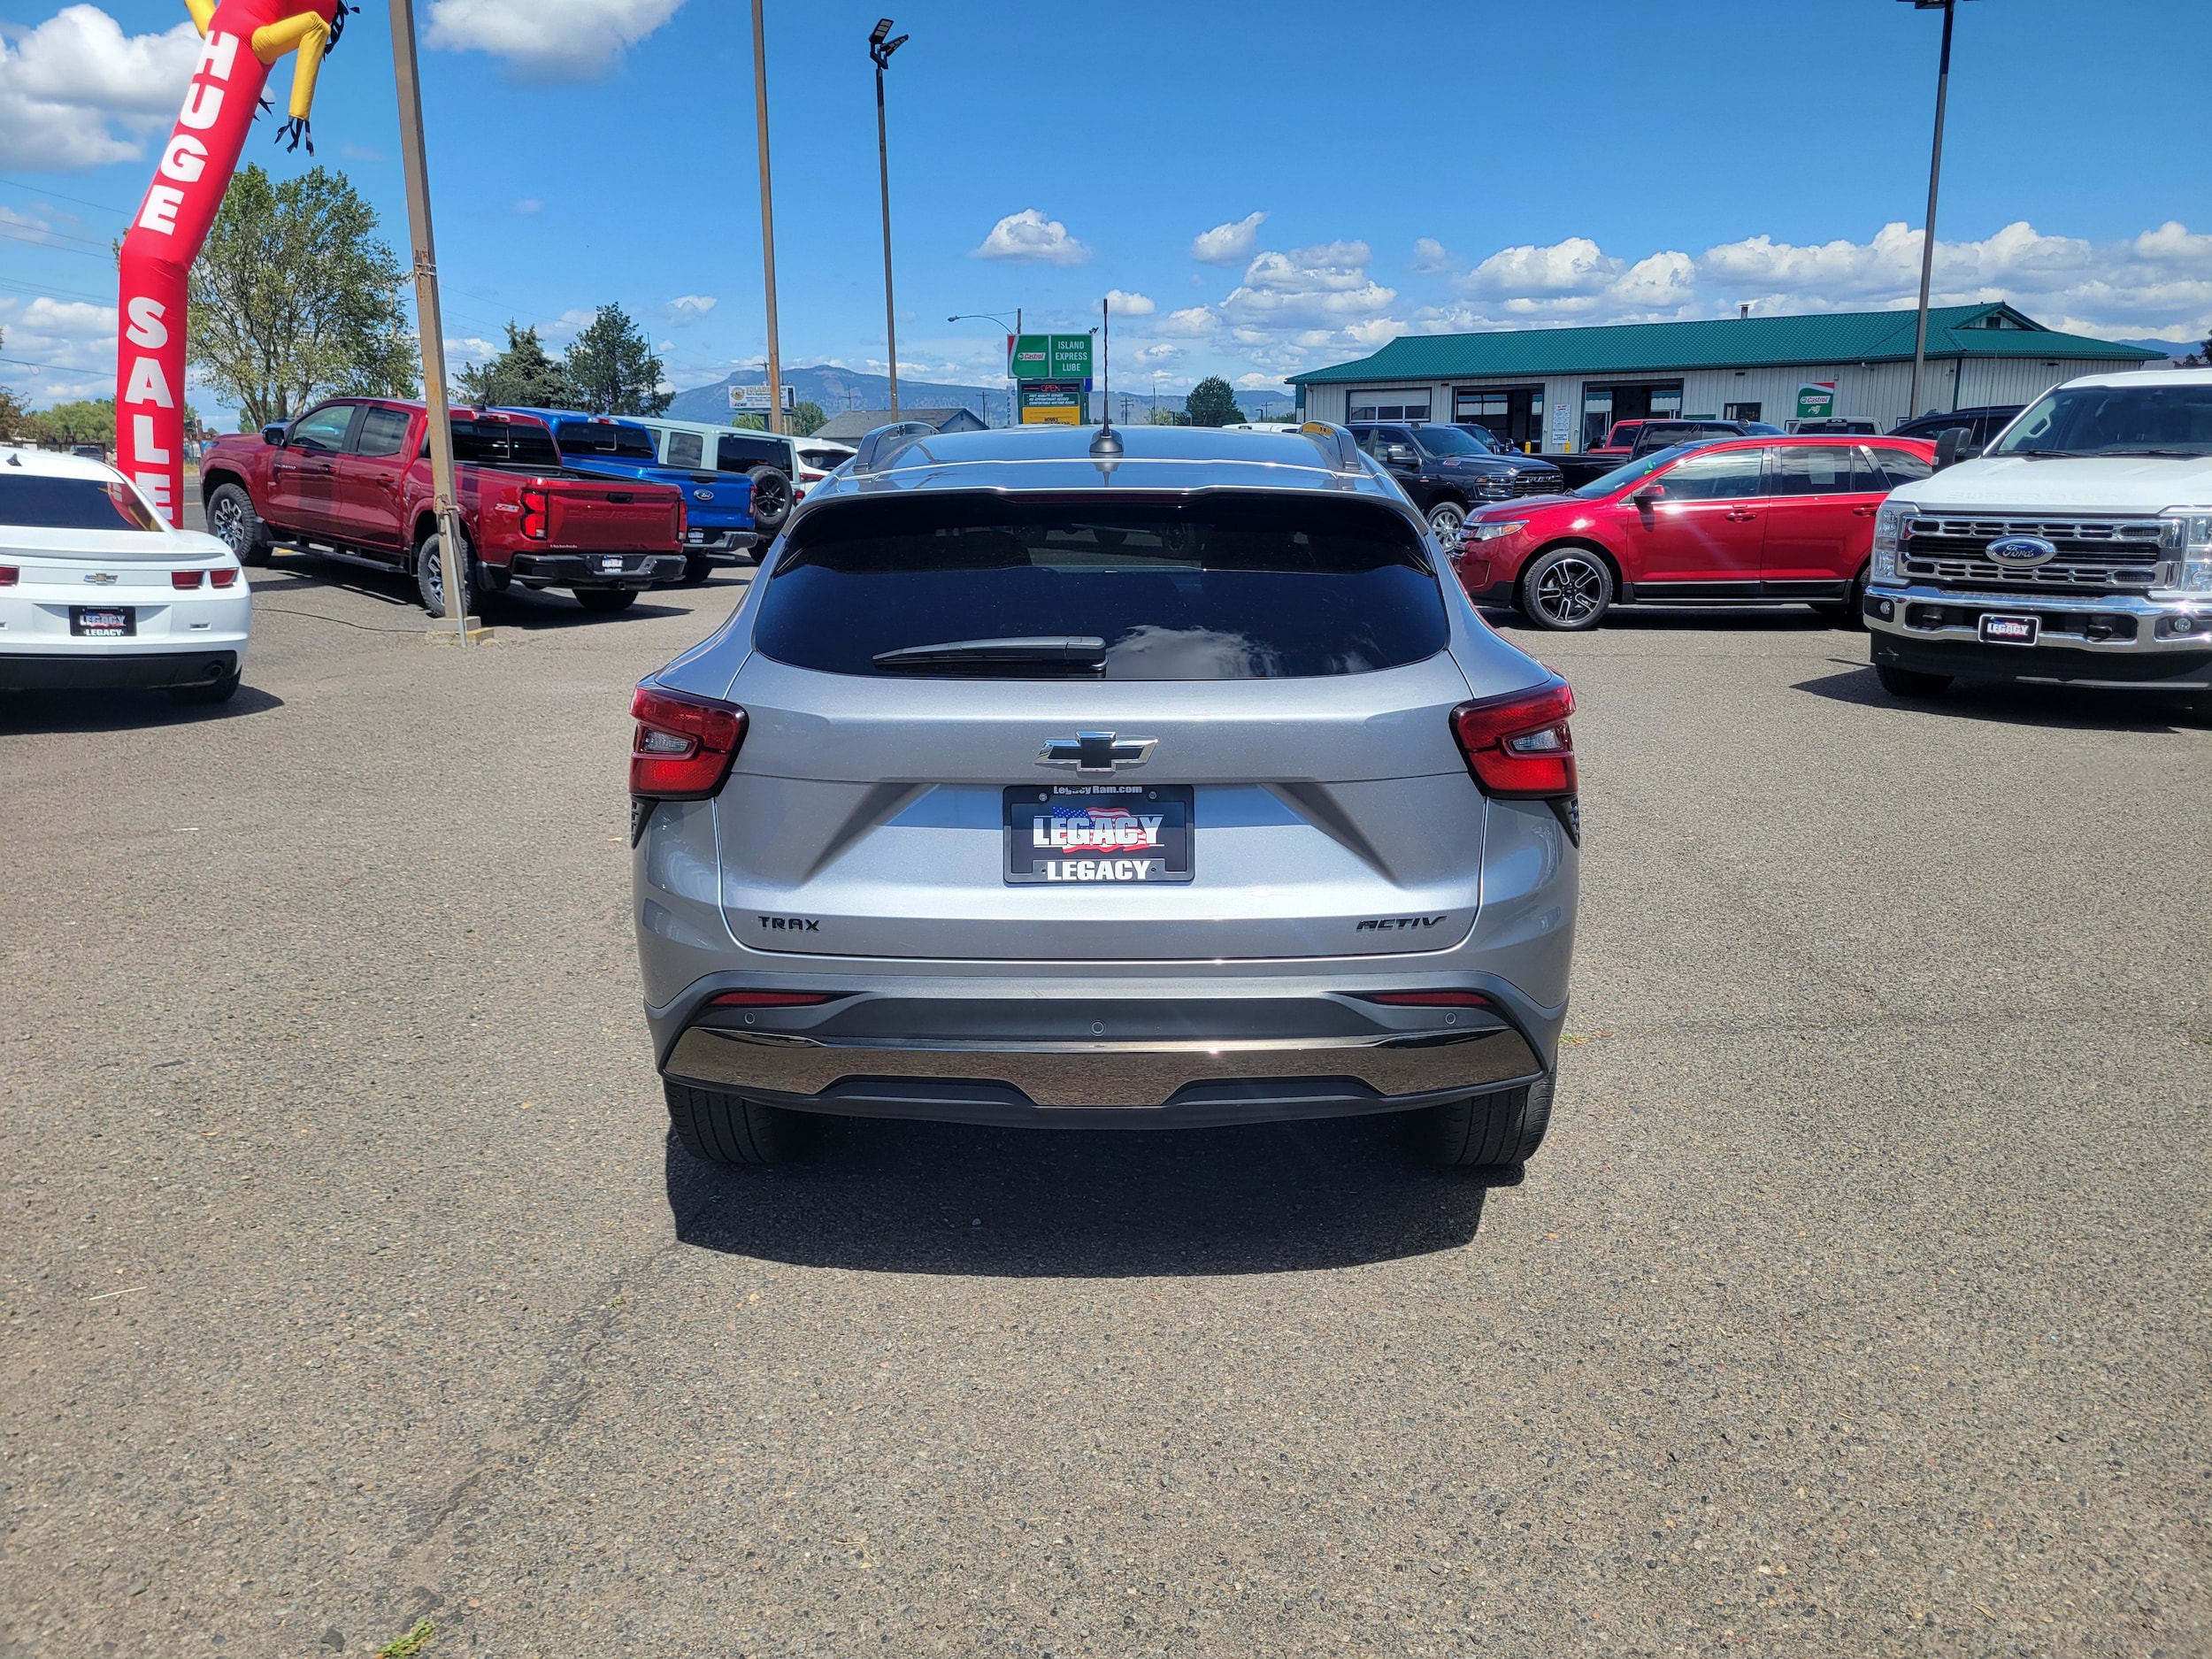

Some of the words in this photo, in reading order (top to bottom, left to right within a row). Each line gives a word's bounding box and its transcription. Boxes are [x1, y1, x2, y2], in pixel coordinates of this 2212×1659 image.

[138, 30, 239, 235] HUGE
[1058, 341, 1085, 349] ISLAND
[125, 296, 175, 520] SALE
[2002, 544, 2034, 558] Ford
[80, 615, 127, 626] LEGACY
[1987, 623, 2029, 636] LEGACY
[1033, 817, 1164, 846] LEGACY
[1047, 860, 1151, 880] LEGACY
[757, 915, 819, 932] TRAX
[1356, 916, 1448, 930] ACTIV
